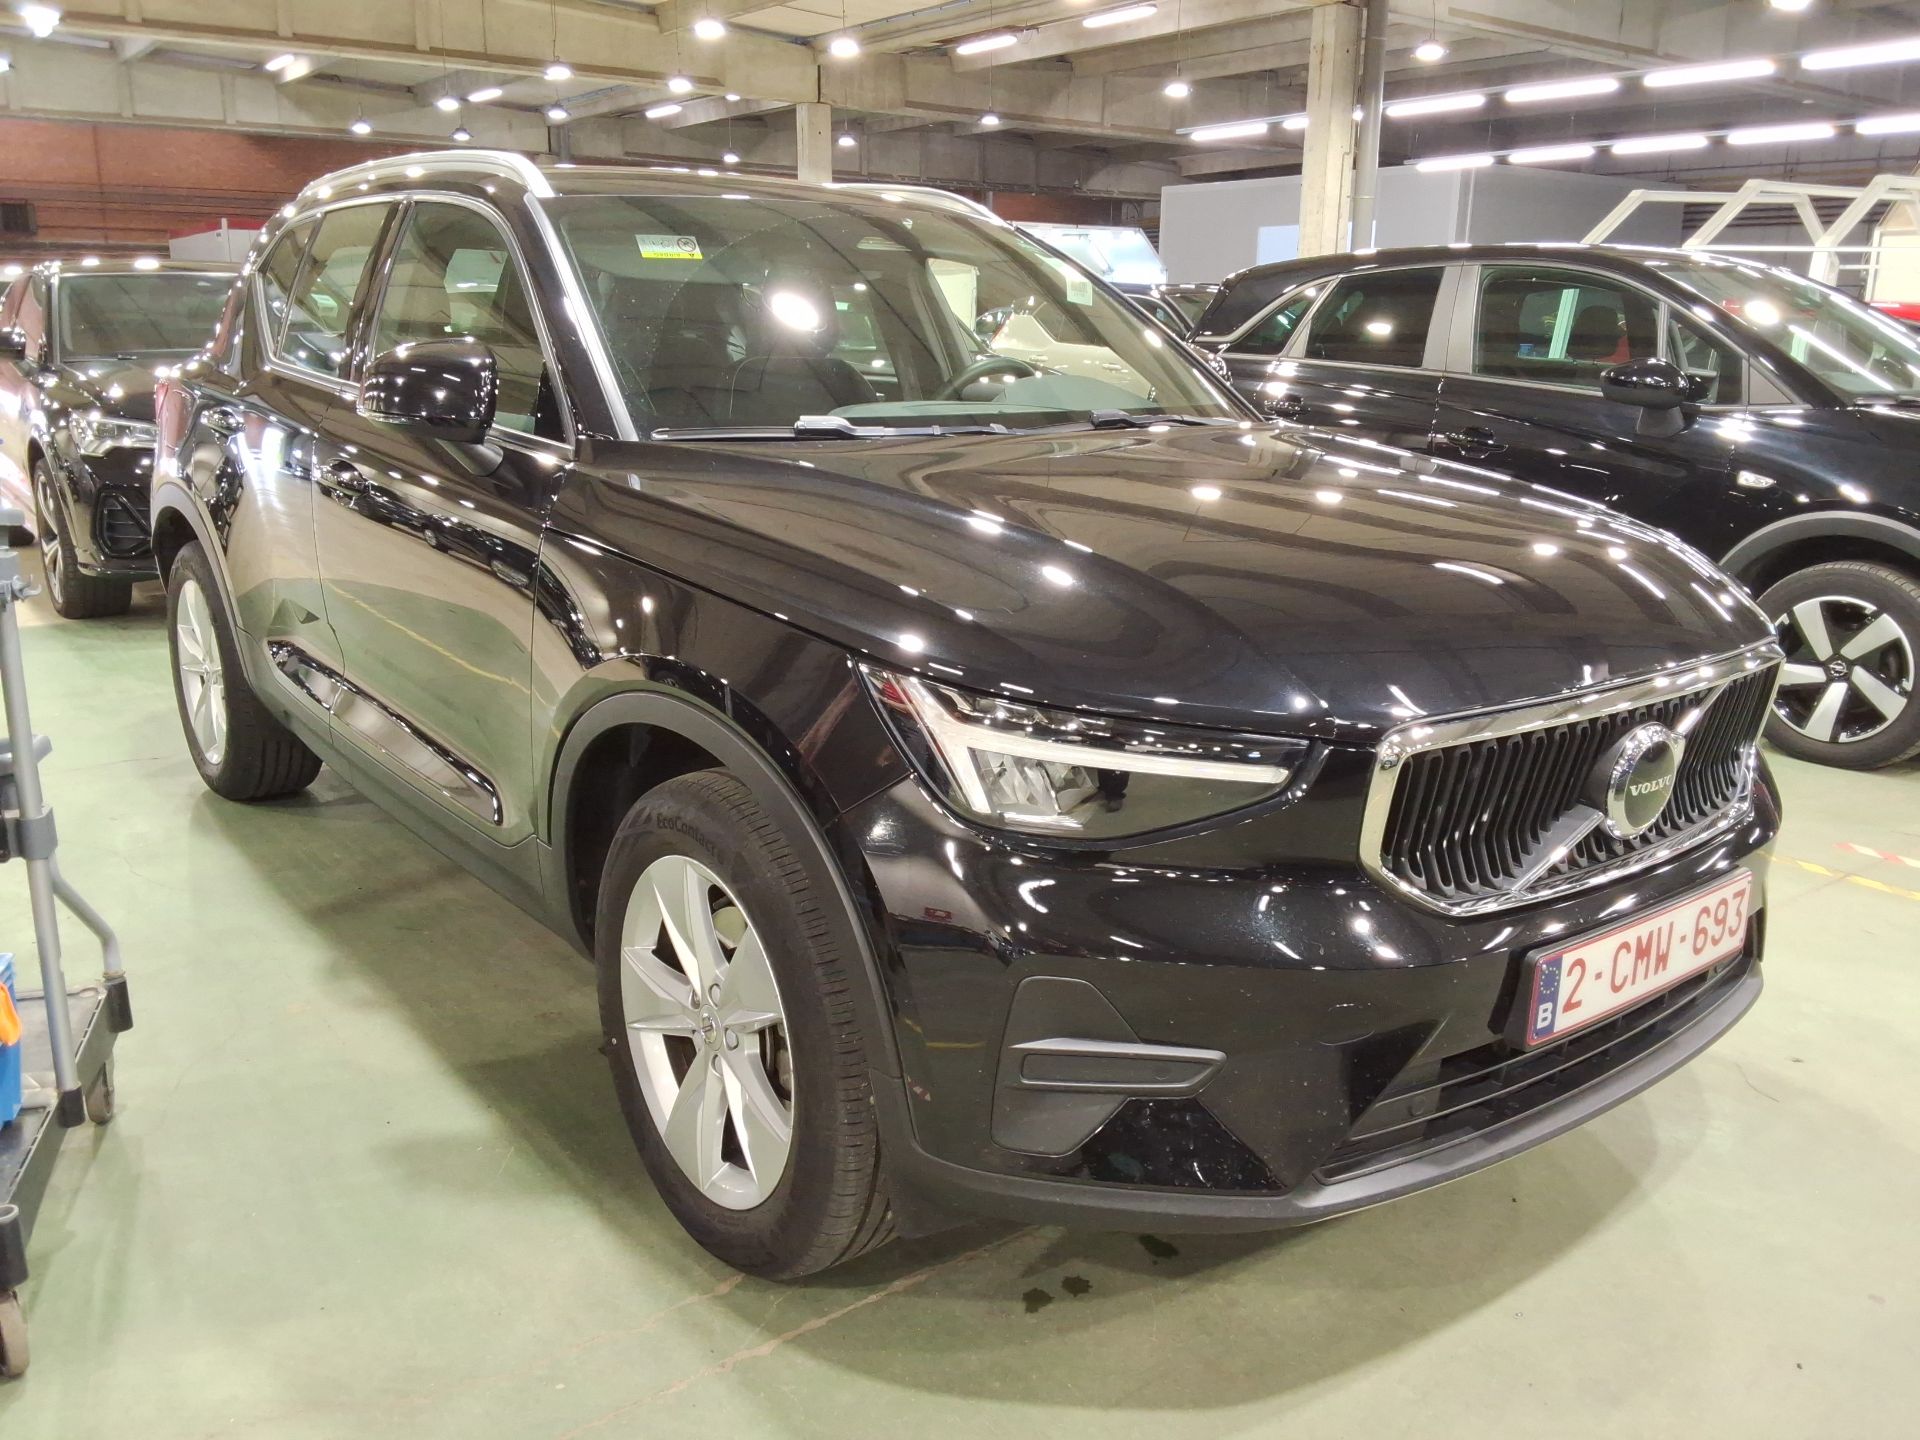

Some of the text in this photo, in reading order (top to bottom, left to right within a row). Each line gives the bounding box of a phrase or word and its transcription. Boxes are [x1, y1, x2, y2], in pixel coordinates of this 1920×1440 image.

[1630, 775, 1672, 797] VOLVO
[1562, 888, 1747, 1014] 2-CMW-693
[1536, 1001, 1553, 1030] B
